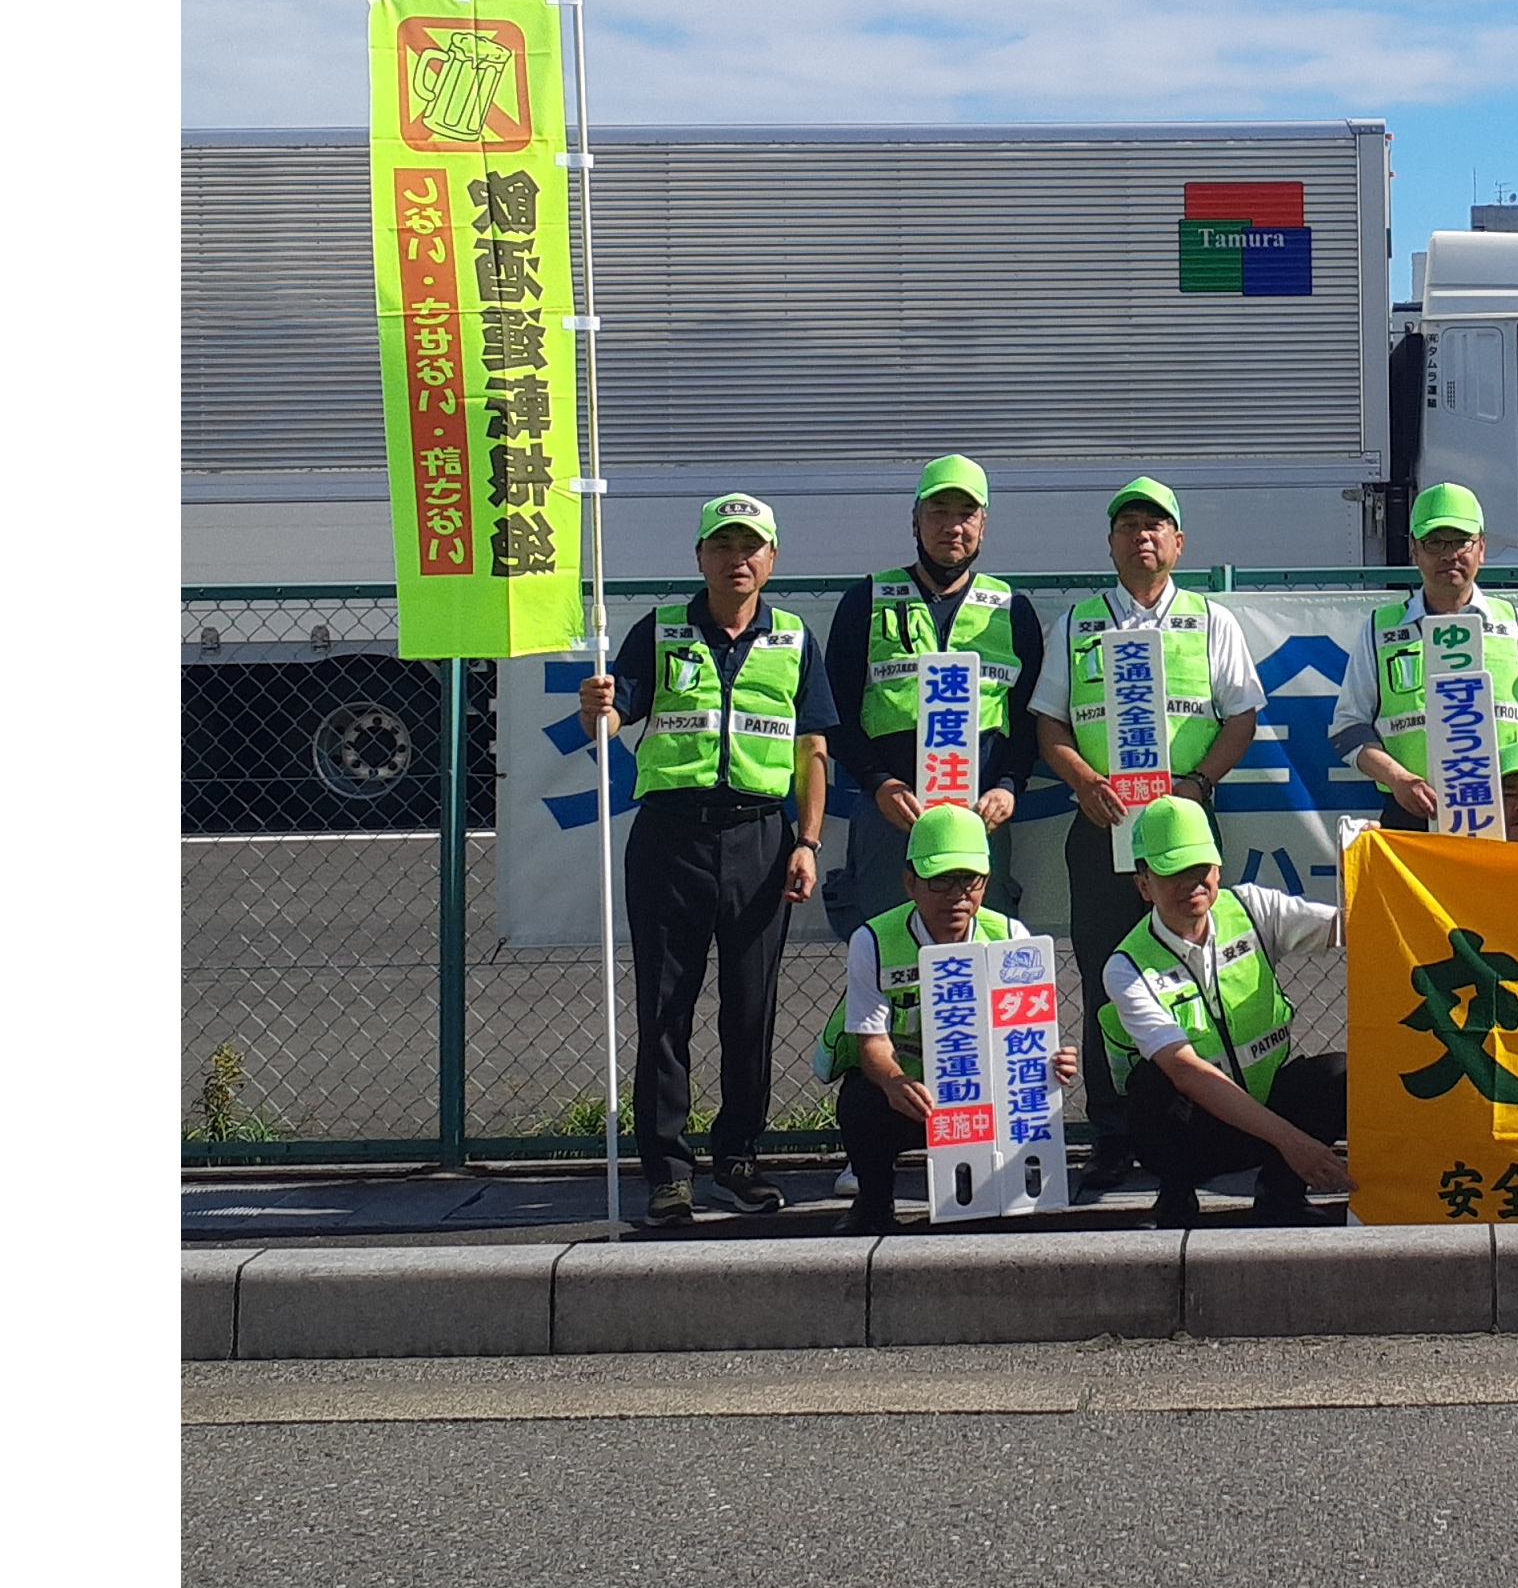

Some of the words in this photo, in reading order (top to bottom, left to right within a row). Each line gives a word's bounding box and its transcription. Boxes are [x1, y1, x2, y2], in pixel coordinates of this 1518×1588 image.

[1198, 227, 1285, 249] Tamura
[880, 584, 911, 597] 交通
[974, 590, 1002, 606] 安全
[1079, 620, 1106, 633] 交通
[1169, 616, 1198, 630] 安全
[1382, 630, 1411, 644] 交通
[1483, 622, 1510, 637] 安全
[662, 627, 694, 640] 交通
[766, 633, 795, 647] 安全
[1432, 623, 1472, 671] ゆっ
[979, 665, 1011, 682] TROL
[1112, 640, 1159, 770] 交通安全運動
[1166, 699, 1205, 715] ATROL
[744, 717, 792, 736] PATROL
[924, 663, 971, 810] 速度注
[1435, 677, 1495, 838] 守ろう交通ル
[1114, 778, 1168, 802] 実施中
[1221, 938, 1252, 962] 安全
[996, 988, 1051, 1022] ダメ
[931, 955, 982, 1104] 交通安全運動
[1250, 1024, 1291, 1059] PATROL
[1002, 1026, 1053, 1144] 飲酒運転
[931, 1110, 991, 1144] 実施中
